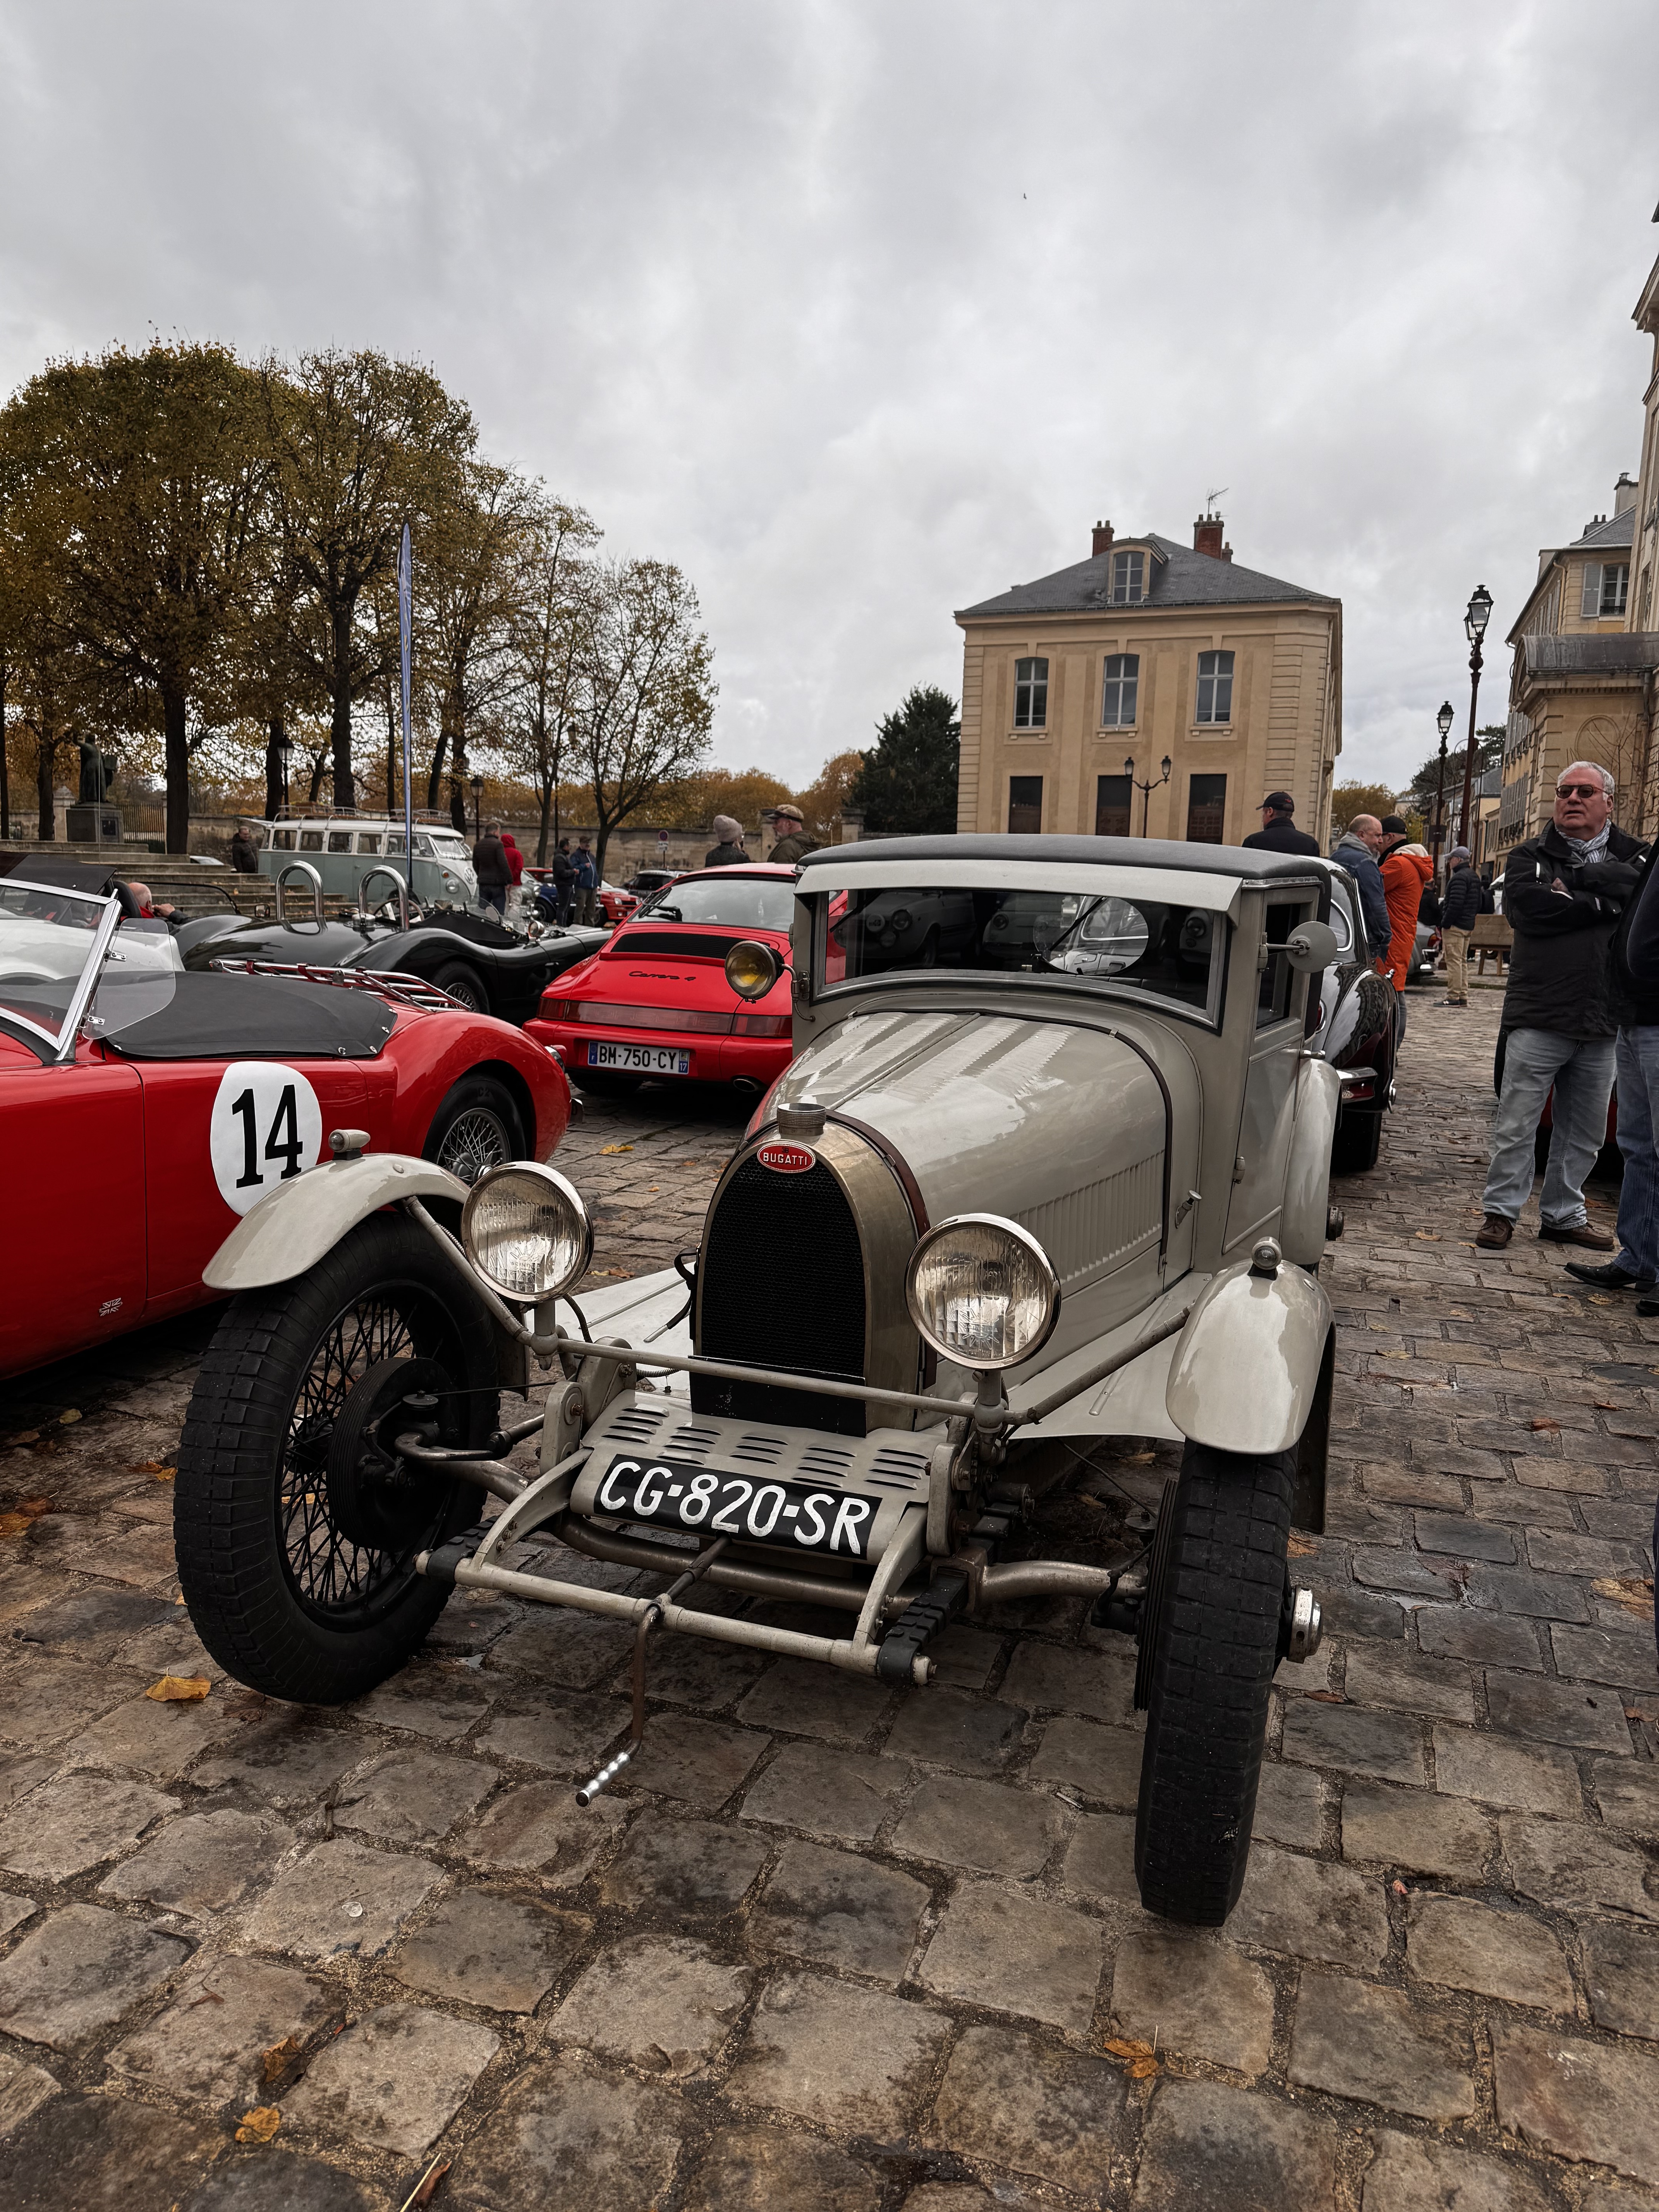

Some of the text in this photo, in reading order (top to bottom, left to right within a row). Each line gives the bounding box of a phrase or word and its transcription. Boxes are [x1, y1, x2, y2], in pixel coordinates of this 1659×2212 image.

[629, 971, 680, 979] Carrera
[582, 1008, 720, 1027] ORSCHE
[599, 1046, 677, 1070] BM-750-CY
[680, 1063, 687, 1071] 17
[232, 1084, 303, 1188] 14
[763, 1152, 807, 1165] BUGATTI
[601, 1462, 870, 1554] CG-820-SR
